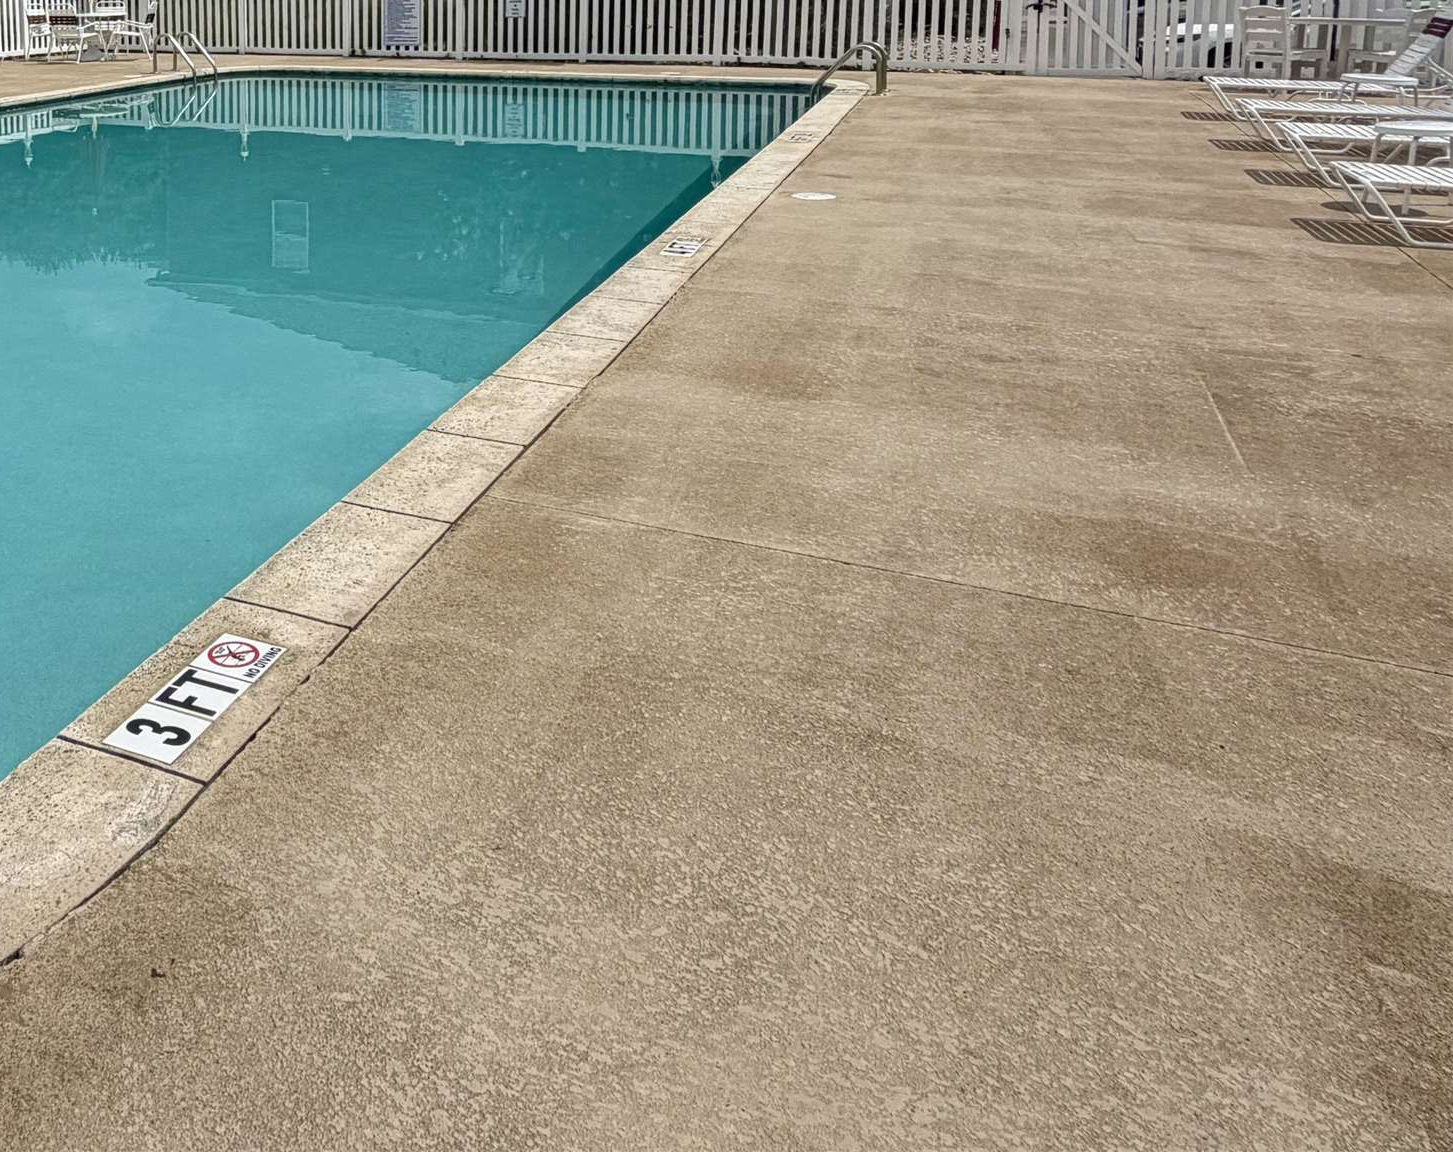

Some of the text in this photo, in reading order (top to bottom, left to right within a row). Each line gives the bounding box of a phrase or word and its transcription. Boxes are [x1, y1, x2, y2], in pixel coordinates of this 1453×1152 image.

[243, 647, 282, 679] NO DIVING
[125, 668, 240, 746] 3 FT
